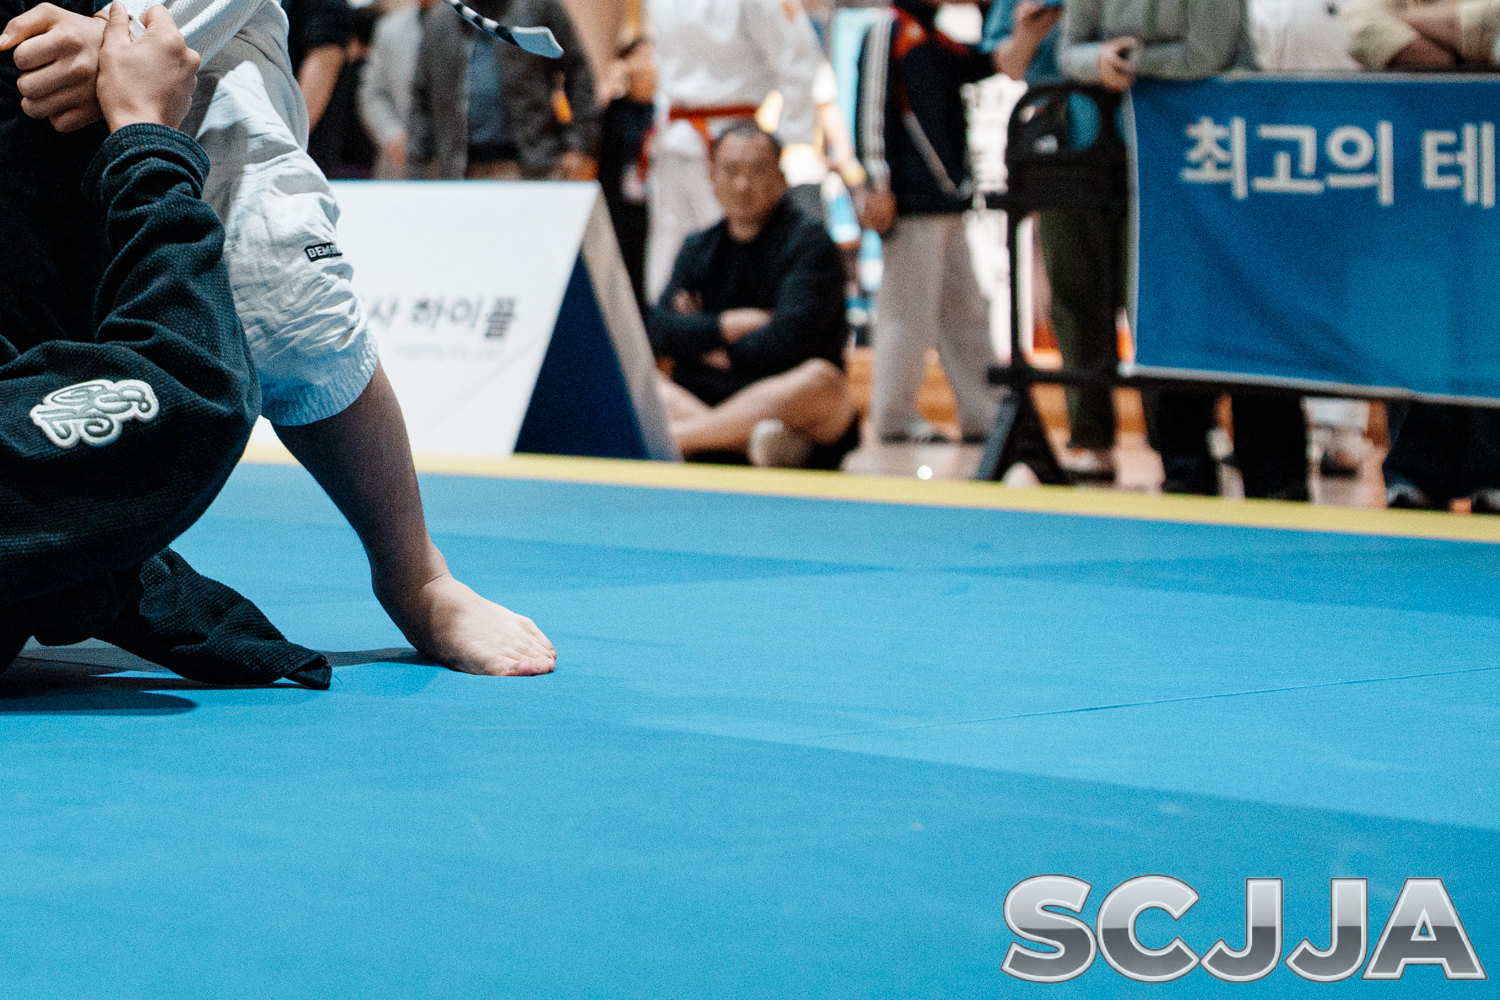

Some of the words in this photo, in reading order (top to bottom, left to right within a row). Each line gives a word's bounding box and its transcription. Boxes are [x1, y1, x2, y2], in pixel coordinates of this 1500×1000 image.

[1180, 116, 1395, 207] 최고의
[1420, 121, 1497, 210] 테
[411, 295, 518, 339] 하이플
